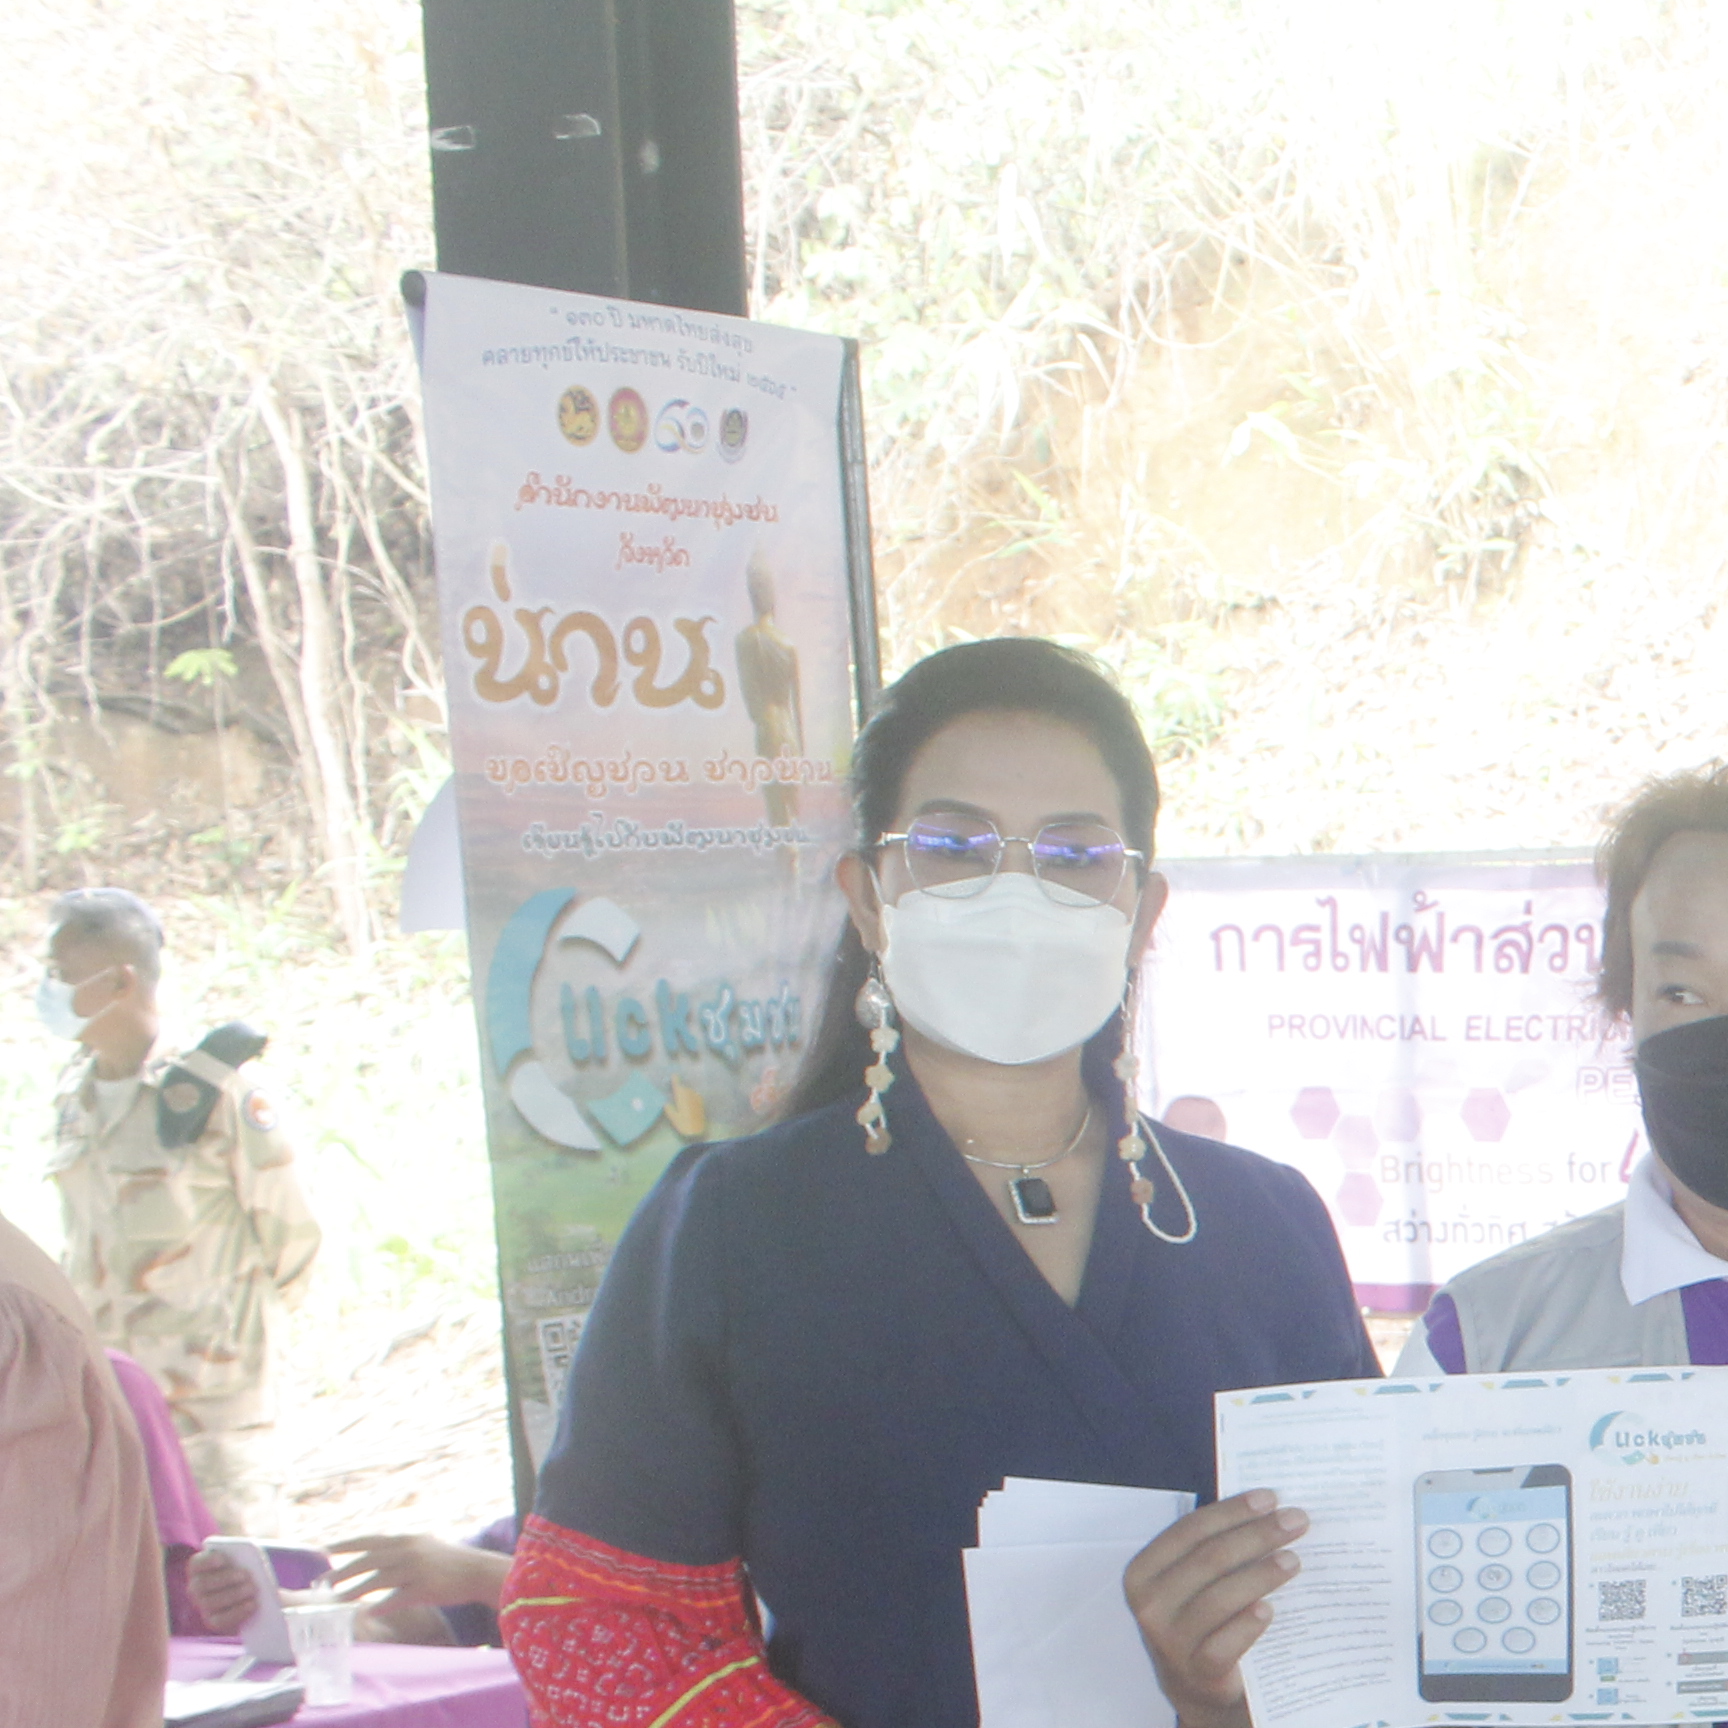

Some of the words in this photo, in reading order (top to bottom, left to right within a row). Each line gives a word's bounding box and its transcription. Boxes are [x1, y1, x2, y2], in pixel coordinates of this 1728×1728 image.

[461, 540, 727, 712] น่าน
[1267, 1012, 1447, 1043] PROVINCIAL
[1575, 1065, 1638, 1106] PE
[1380, 1151, 1553, 1193] Brightness
[1567, 1151, 1613, 1183] for
